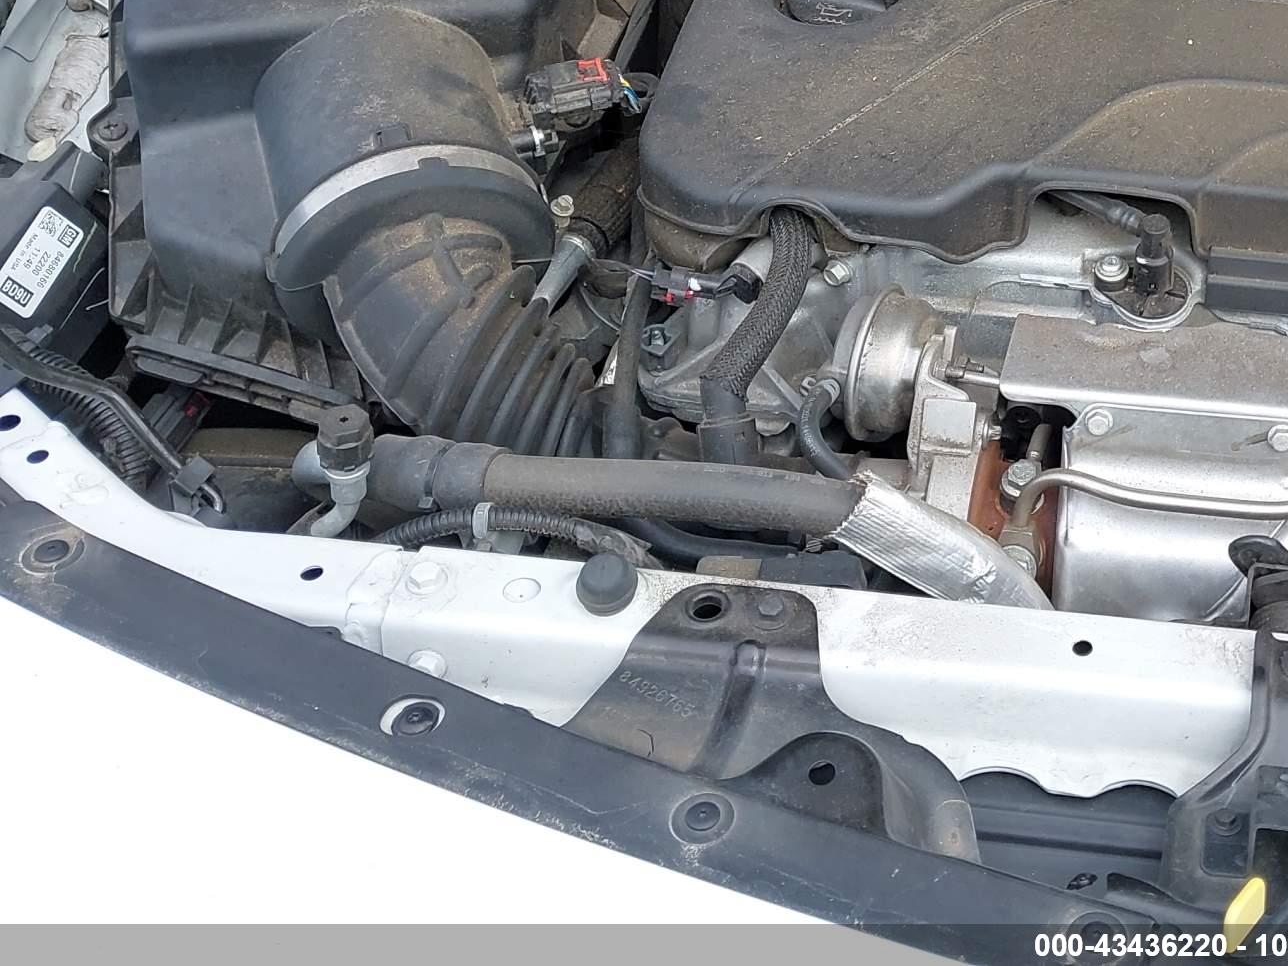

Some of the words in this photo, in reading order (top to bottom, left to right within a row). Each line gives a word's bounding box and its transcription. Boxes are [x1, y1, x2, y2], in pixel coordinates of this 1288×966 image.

[24, 246, 41, 270] 11:49
[32, 250, 51, 276] 22200
[2, 280, 31, 305] BD9U
